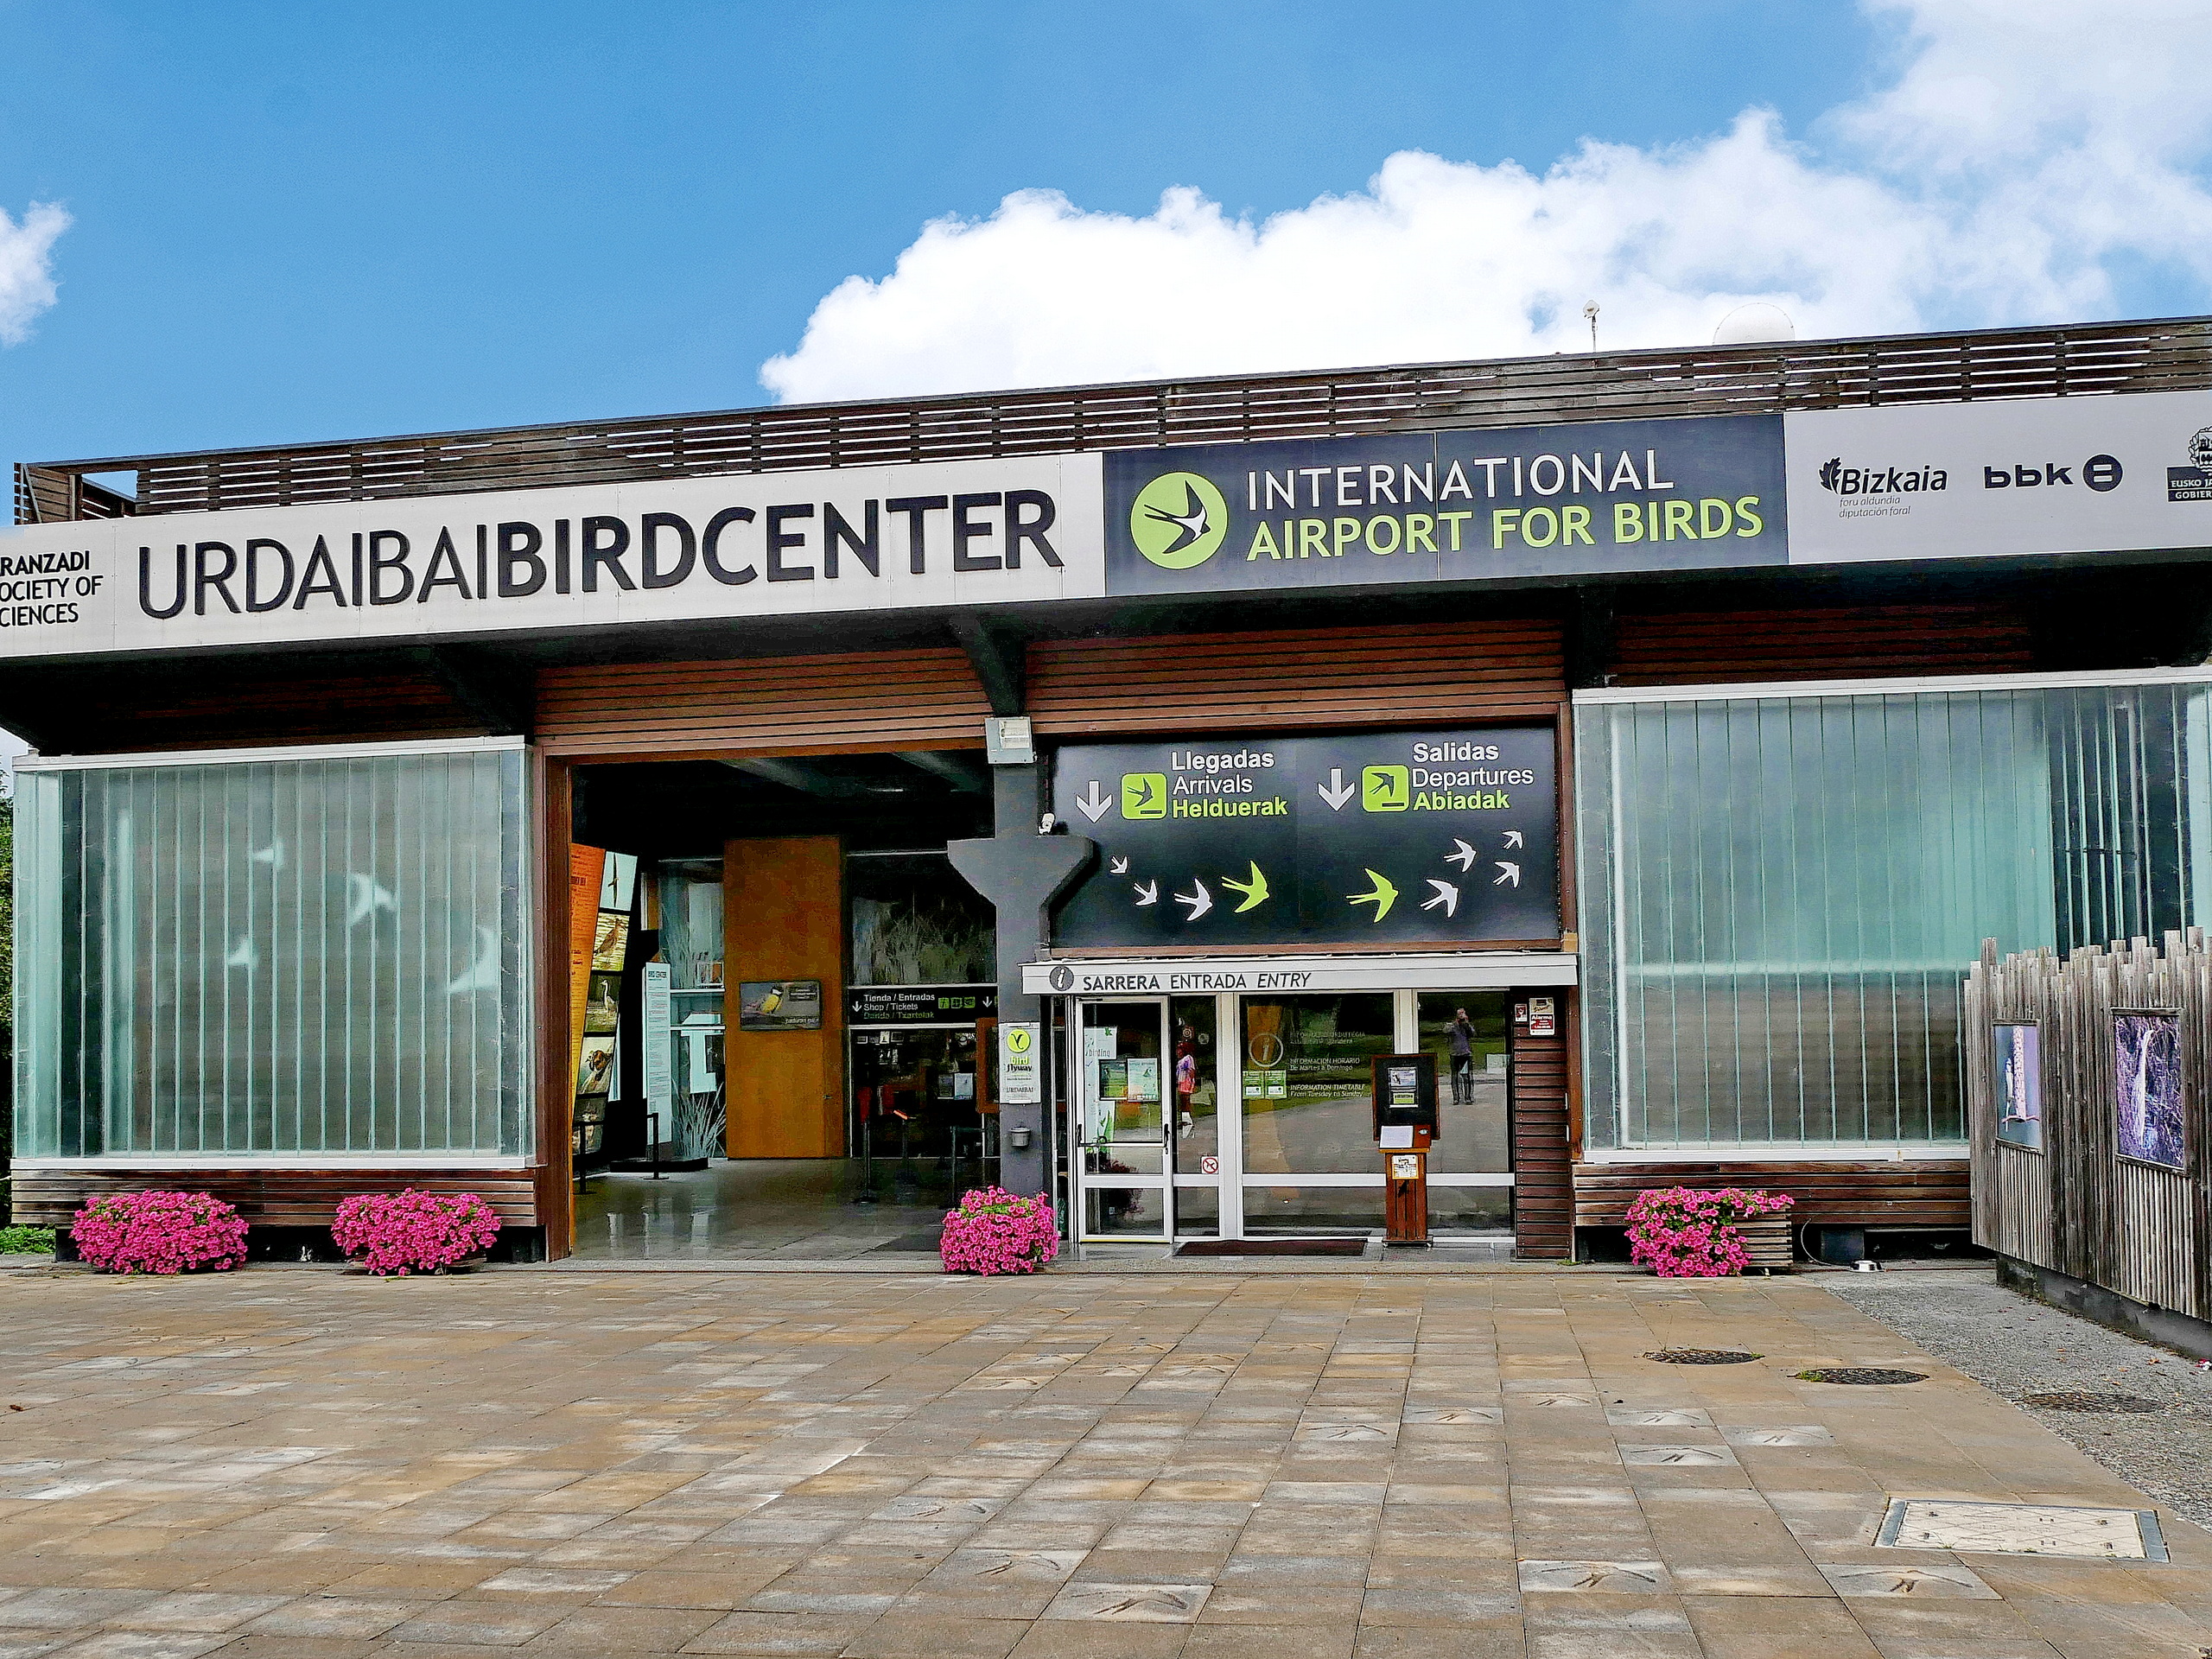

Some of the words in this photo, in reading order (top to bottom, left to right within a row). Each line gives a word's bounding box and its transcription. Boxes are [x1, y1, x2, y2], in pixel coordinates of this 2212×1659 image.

[1248, 448, 1675, 511] INTERNATIONAL
[1840, 465, 1948, 496] Bizkaia
[1983, 462, 2074, 490] bbk
[2171, 479, 2202, 488] EUSKO
[1839, 506, 1887, 519] diputación
[1889, 505, 1911, 517] foral
[1840, 498, 1859, 508] foru
[1860, 495, 1901, 506] aldundia
[1246, 510, 1472, 562] AIRPORT
[1492, 504, 1596, 551] FOR
[1614, 495, 1764, 543] BIRDS
[0, 550, 90, 577] RANZADI
[138, 488, 1065, 620] URDAIBAIBIRDCENTER
[0, 577, 70, 602] OCIETY
[76, 575, 104, 596] OF
[0, 602, 79, 627] CIENCES
[1171, 749, 1274, 772] Llegadas
[1413, 741, 1500, 762] Salidas
[1173, 772, 1254, 795] Arrivals
[1412, 765, 1535, 790] Departures
[1172, 796, 1287, 818] Helduerak
[1413, 789, 1510, 811] Abiadak
[1083, 974, 1160, 991] SARRERA
[1171, 974, 1247, 989] ENTRADA
[1257, 972, 1312, 988] ENTRY
[864, 1002, 884, 1012] Shop
[1006, 1064, 1033, 1072] flyway
[1010, 1056, 1029, 1065] bird
